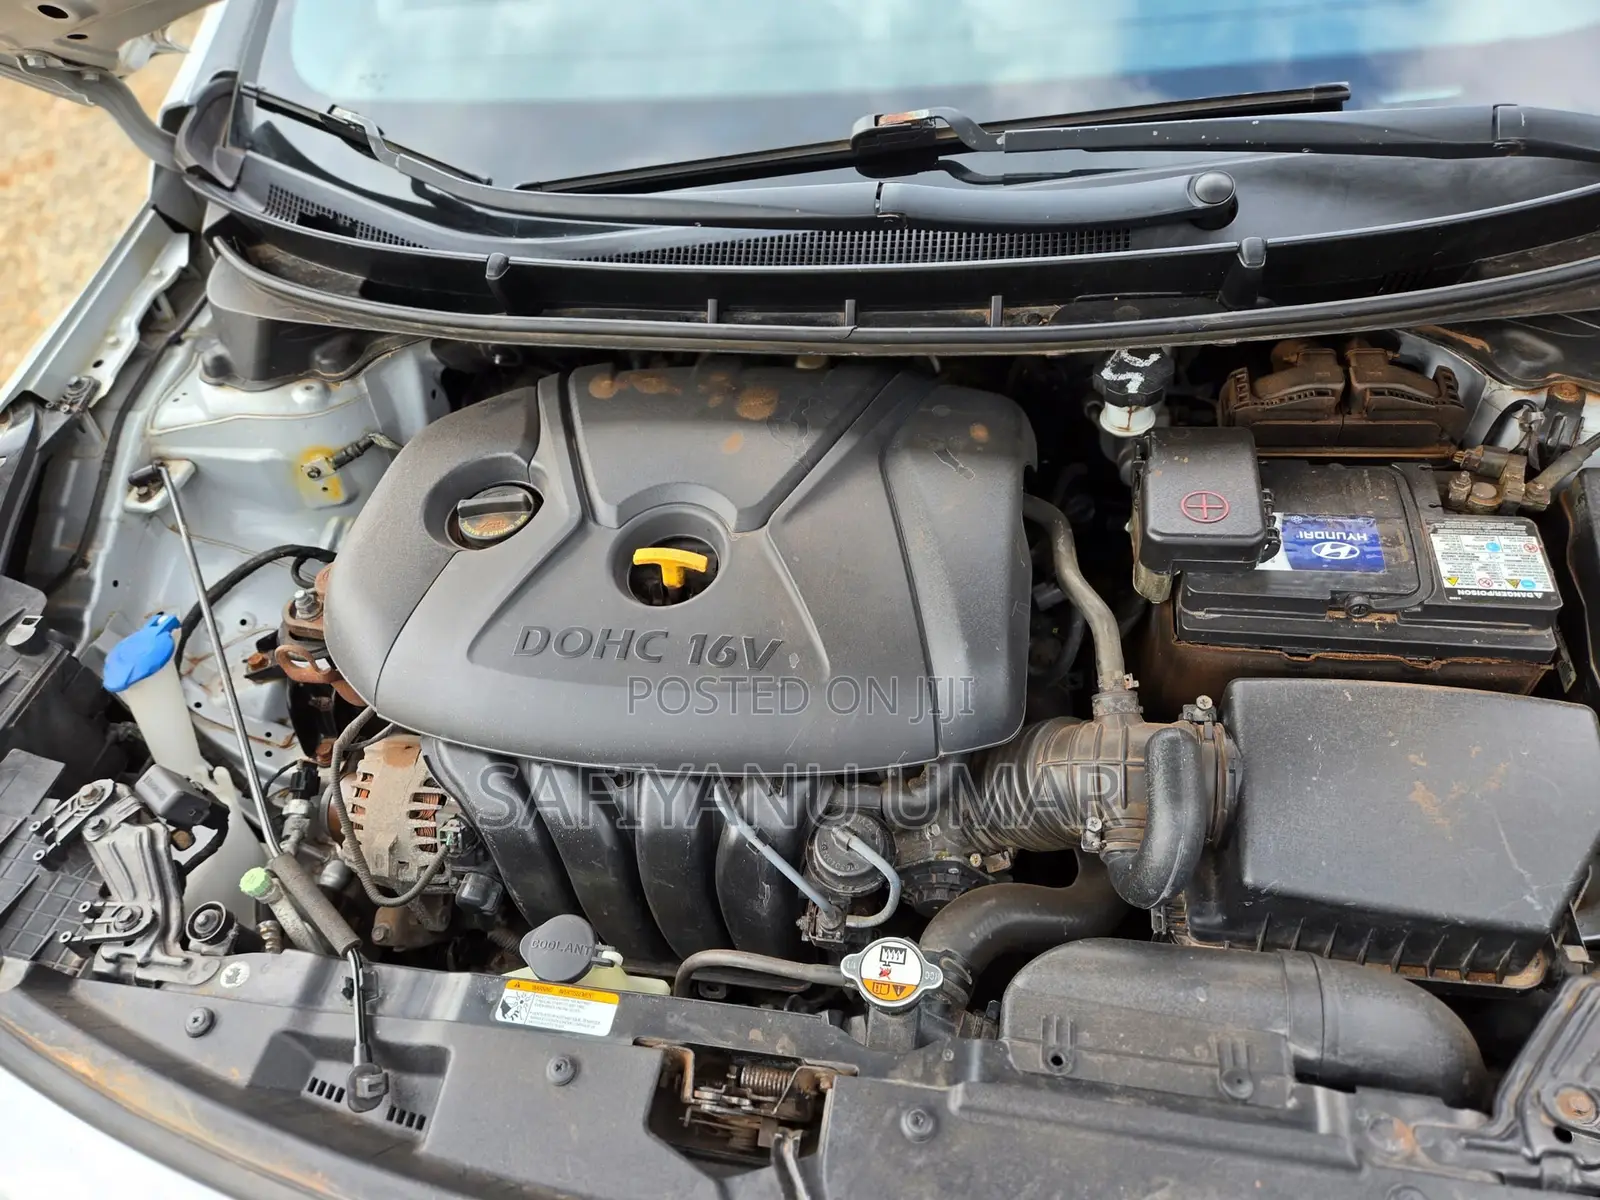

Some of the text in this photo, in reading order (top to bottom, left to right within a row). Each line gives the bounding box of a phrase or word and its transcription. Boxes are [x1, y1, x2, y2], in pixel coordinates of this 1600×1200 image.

[1299, 530, 1369, 542] HYUNDAI
[1457, 589, 1534, 599] DANGER/POISON
[512, 625, 784, 672] DOHC 16V
[531, 939, 593, 956] COOLANT
